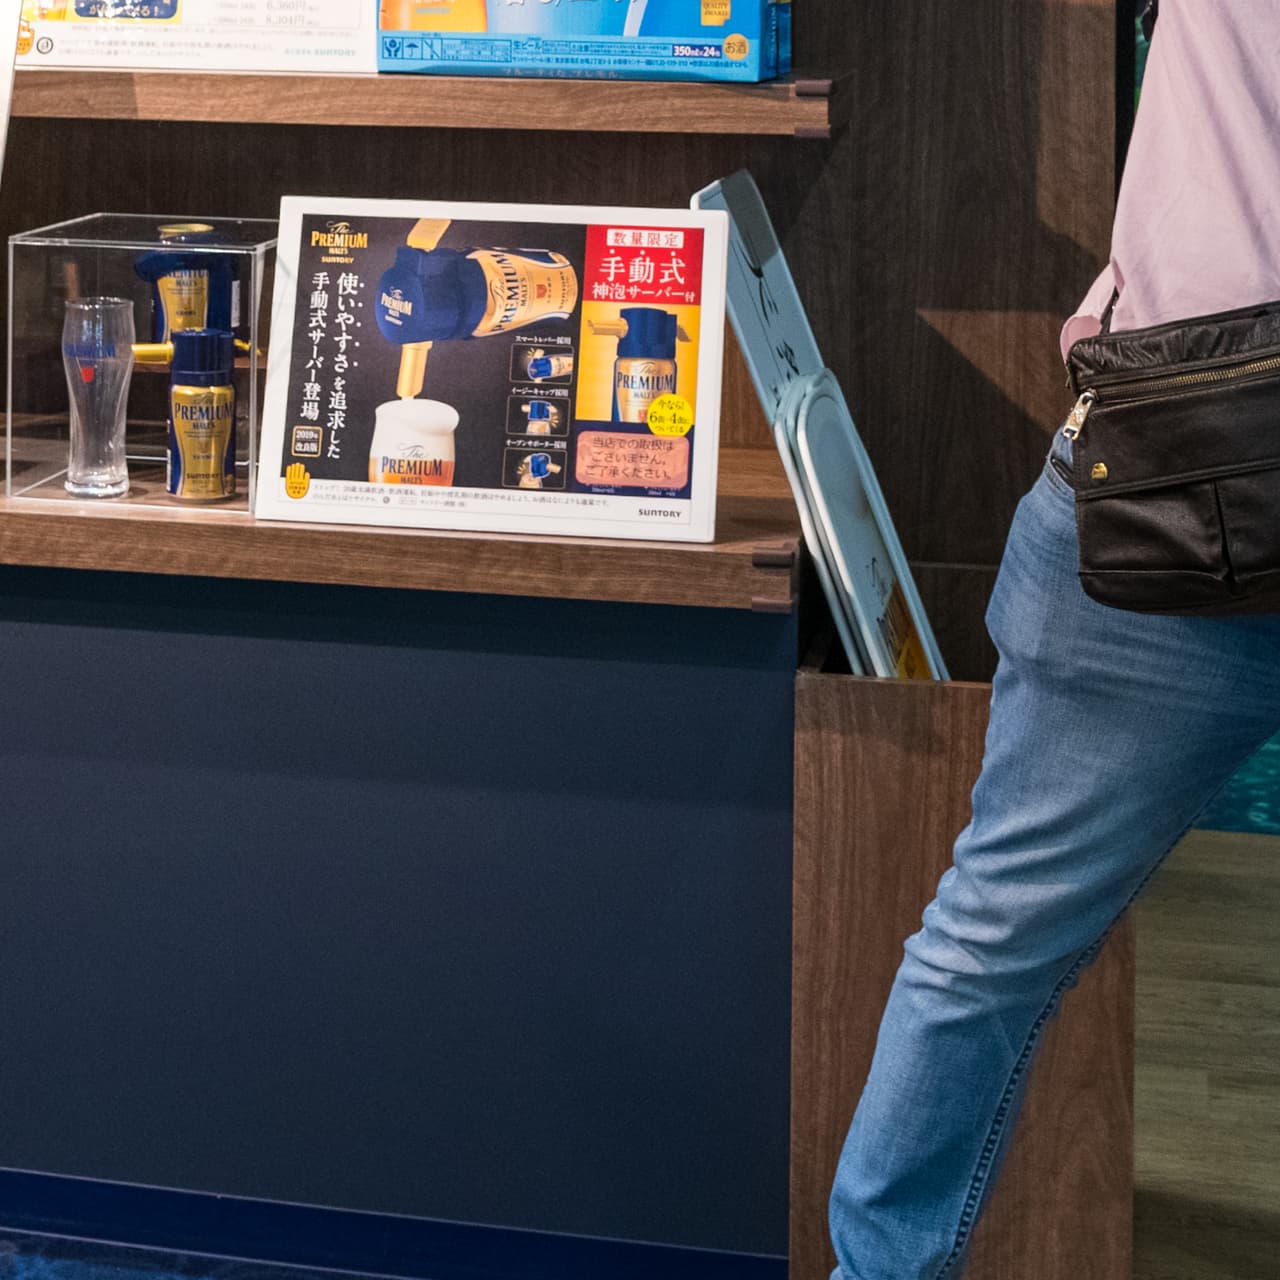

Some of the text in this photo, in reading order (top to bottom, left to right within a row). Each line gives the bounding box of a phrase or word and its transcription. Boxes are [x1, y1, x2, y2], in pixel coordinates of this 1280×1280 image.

[311, 230, 369, 249] PREMIUM
[613, 231, 680, 247] 数量限定
[321, 255, 355, 265] SUNTORY
[599, 256, 687, 285] 手動式
[490, 253, 520, 333] PREMIUM
[592, 281, 696, 304] 神泡サーバー付
[381, 293, 413, 316] PREMIUM
[300, 270, 331, 421] 手動式サーバー登場
[325, 271, 361, 460] 使いやすさを追求した
[617, 373, 674, 390] PREMIUM
[174, 402, 234, 421] PREMIUM
[592, 436, 675, 451] 当店での取扱は
[381, 455, 443, 477] PREMIUM
[591, 452, 667, 466] ございません。
[584, 464, 672, 481] ご了承ください。
[638, 508, 681, 519] SUNTORY
